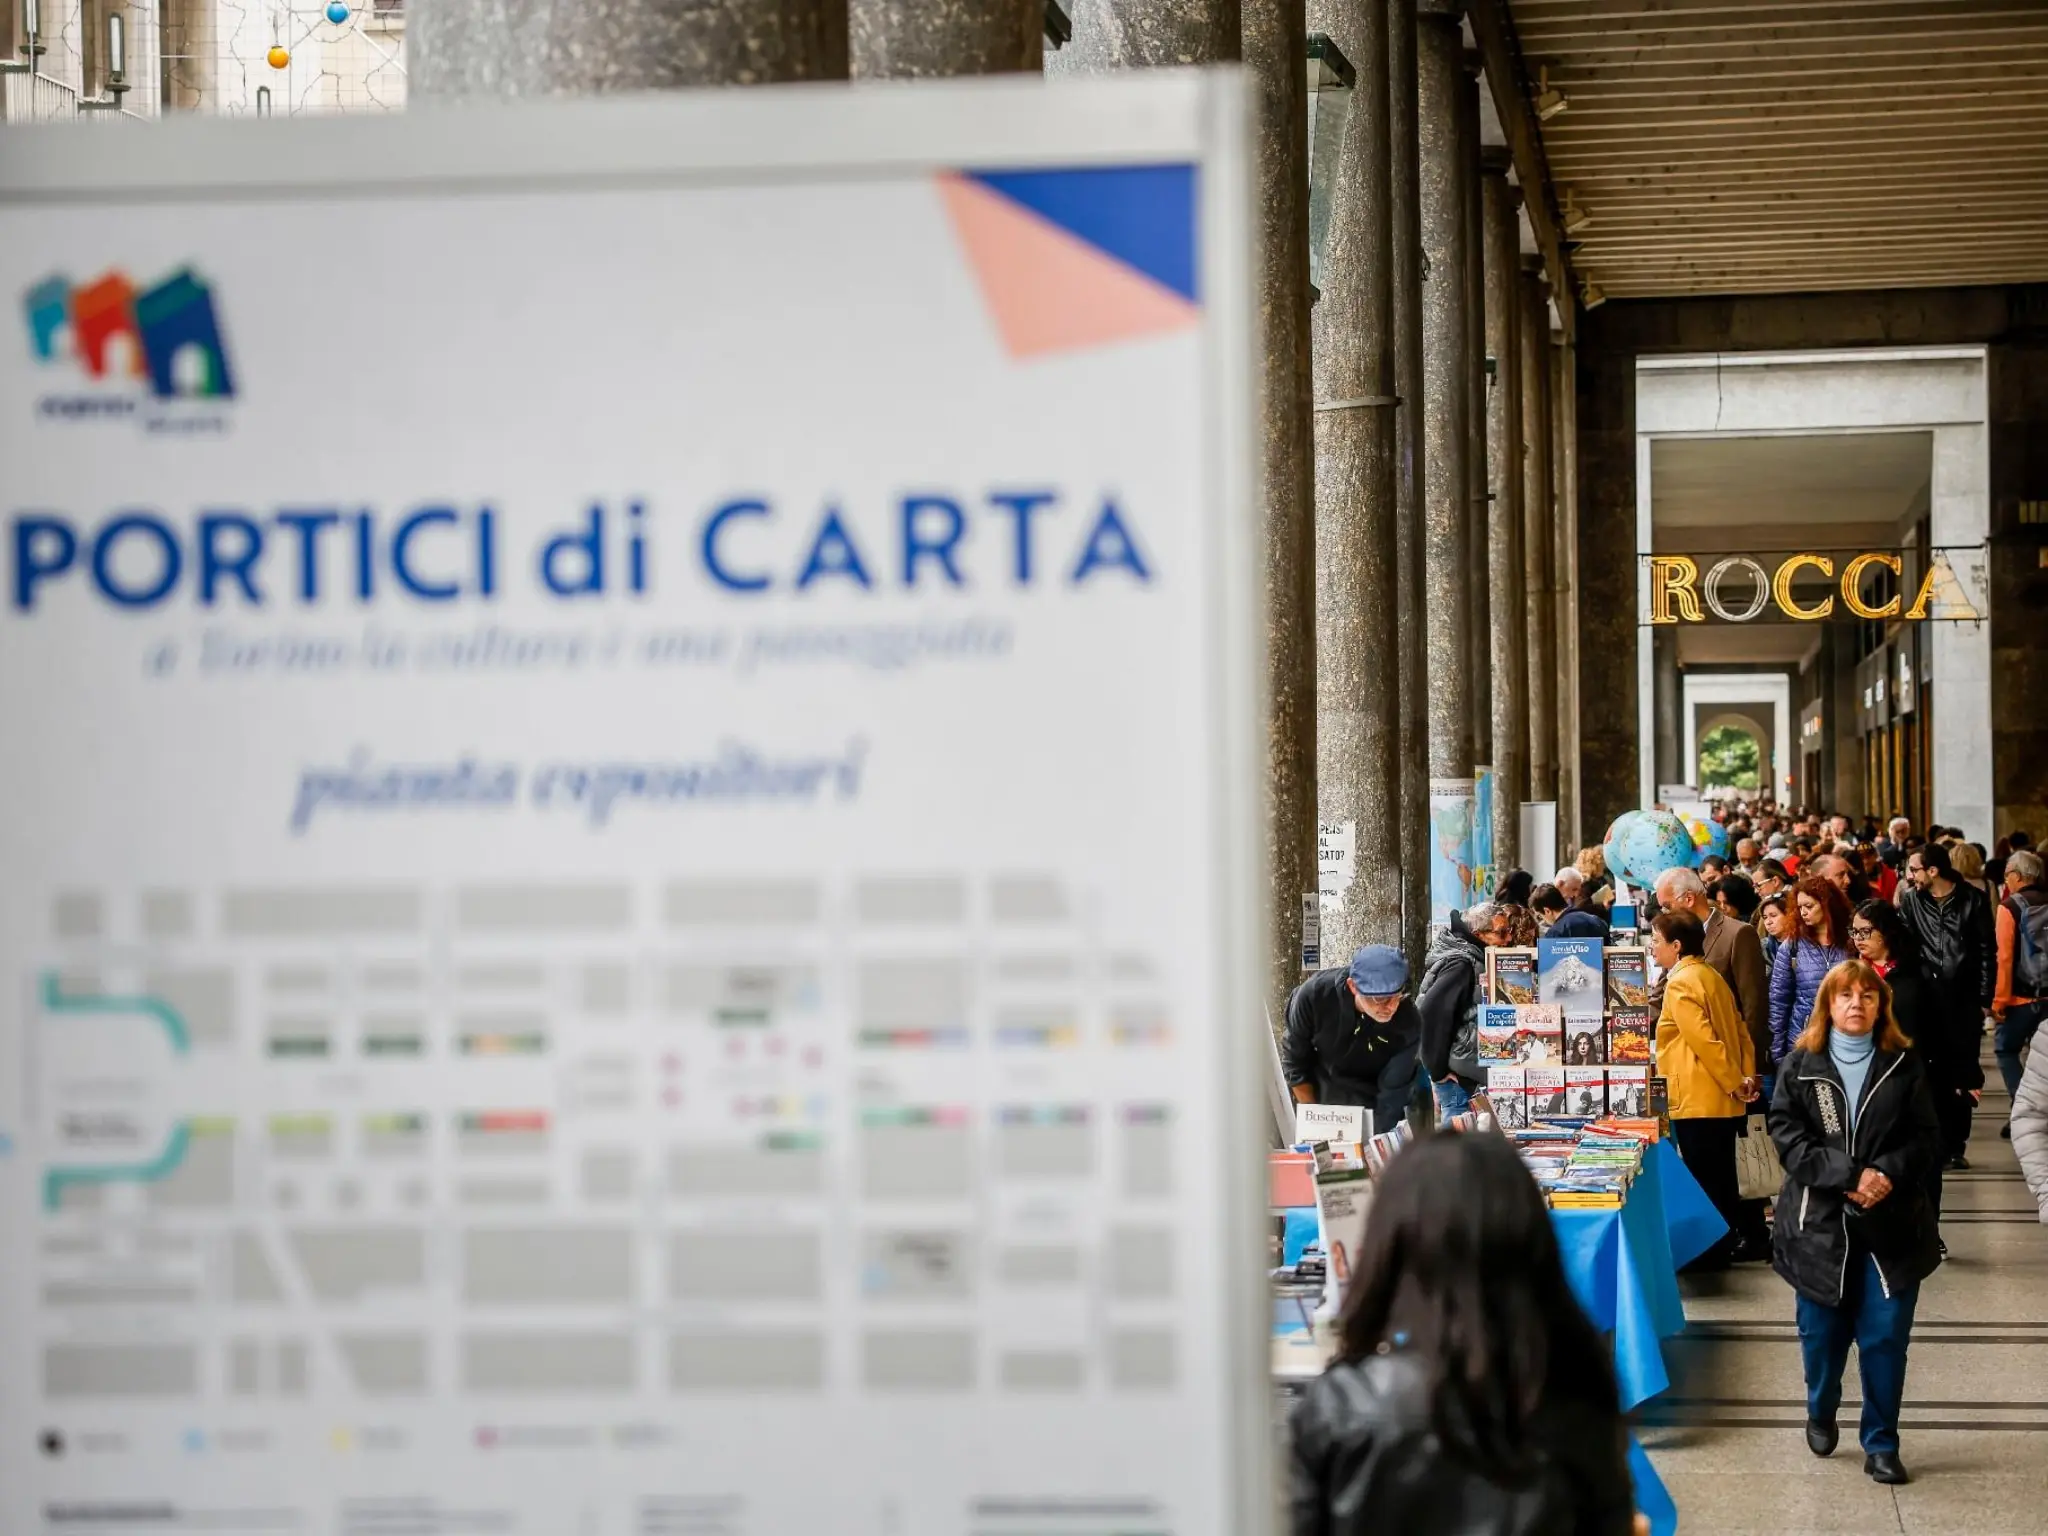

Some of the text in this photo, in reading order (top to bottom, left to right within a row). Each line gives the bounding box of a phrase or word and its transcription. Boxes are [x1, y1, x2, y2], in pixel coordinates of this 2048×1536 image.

[10, 491, 1155, 614] PORTICI di CARTA
[1650, 549, 1981, 624] ROCCA
[1304, 1110, 1354, 1125] Buschesi
